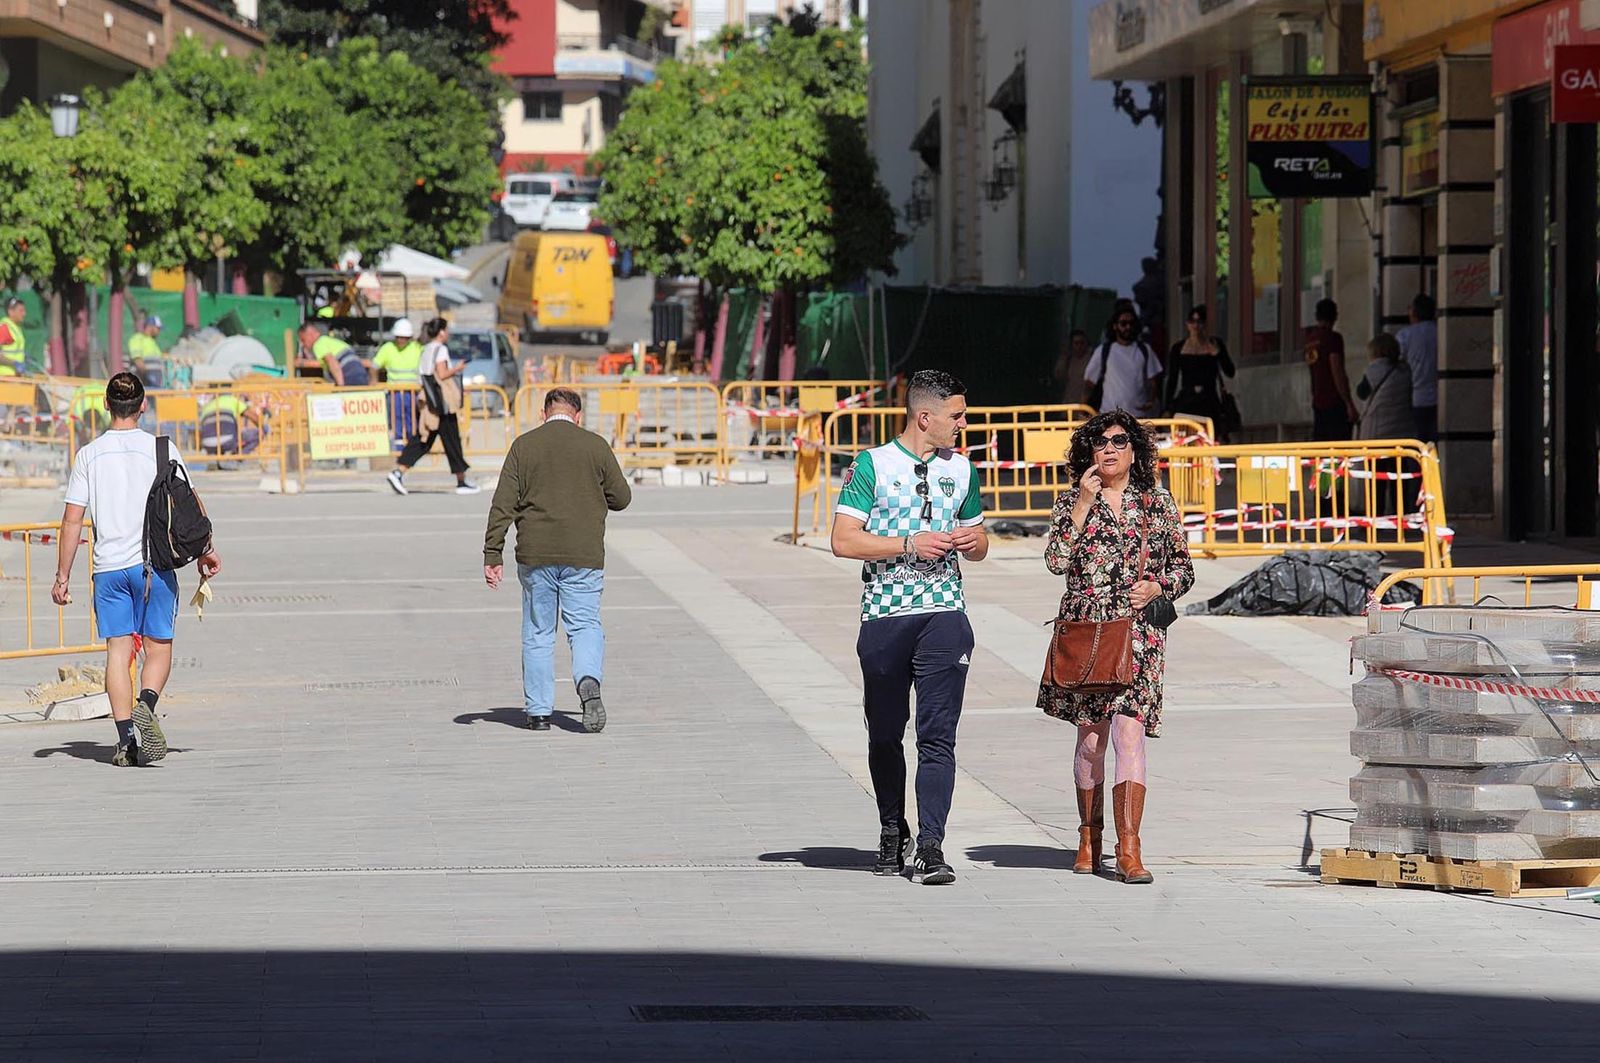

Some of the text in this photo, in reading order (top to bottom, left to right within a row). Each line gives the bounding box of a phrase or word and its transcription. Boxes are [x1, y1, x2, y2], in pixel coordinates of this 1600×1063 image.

[1561, 68, 1600, 90] GA
[1297, 86, 1313, 98] DE
[1316, 101, 1349, 117] Bar
[1249, 121, 1368, 141] PLUS ULTRA
[1273, 157, 1331, 173] RETA
